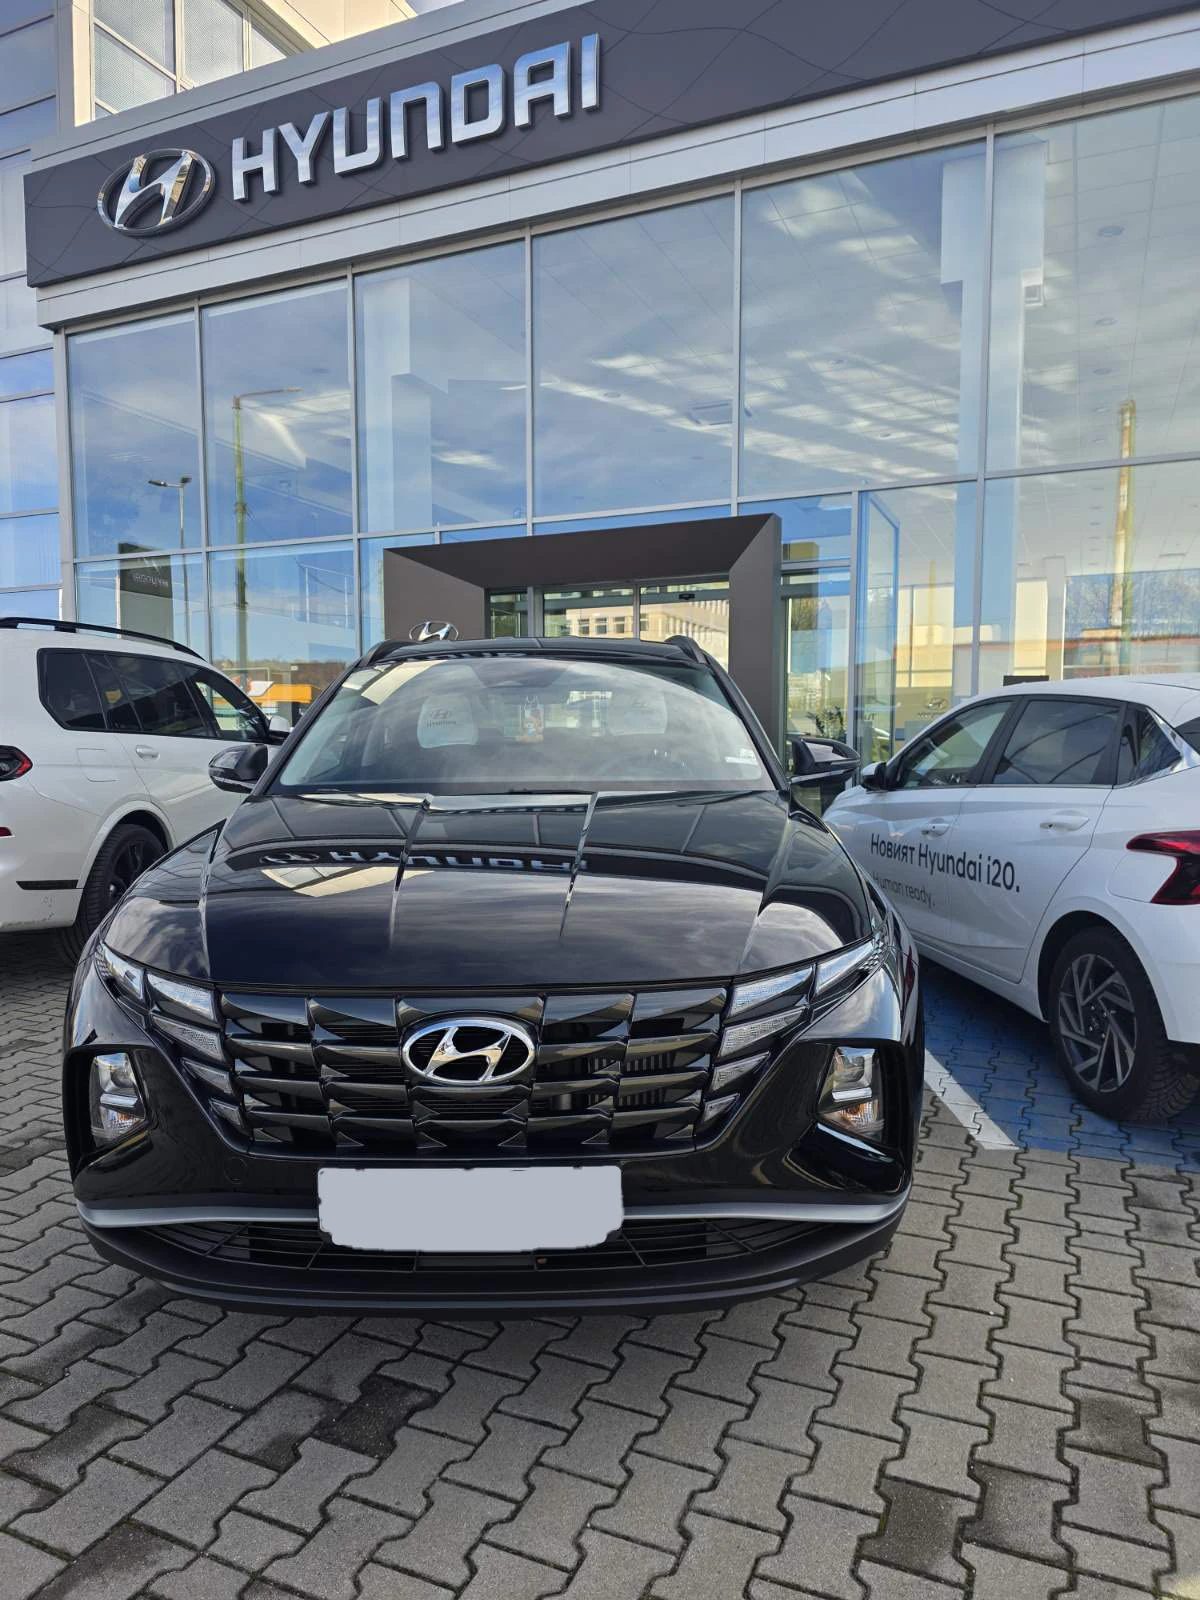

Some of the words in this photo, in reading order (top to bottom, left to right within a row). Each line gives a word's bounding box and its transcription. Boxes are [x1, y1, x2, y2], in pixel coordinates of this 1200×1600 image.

[231, 32, 600, 202] HYUNDAI
[870, 833, 915, 864] Новият
[918, 843, 982, 883] Hyundai
[986, 855, 1020, 893] i20.
[904, 884, 936, 909] ready.
